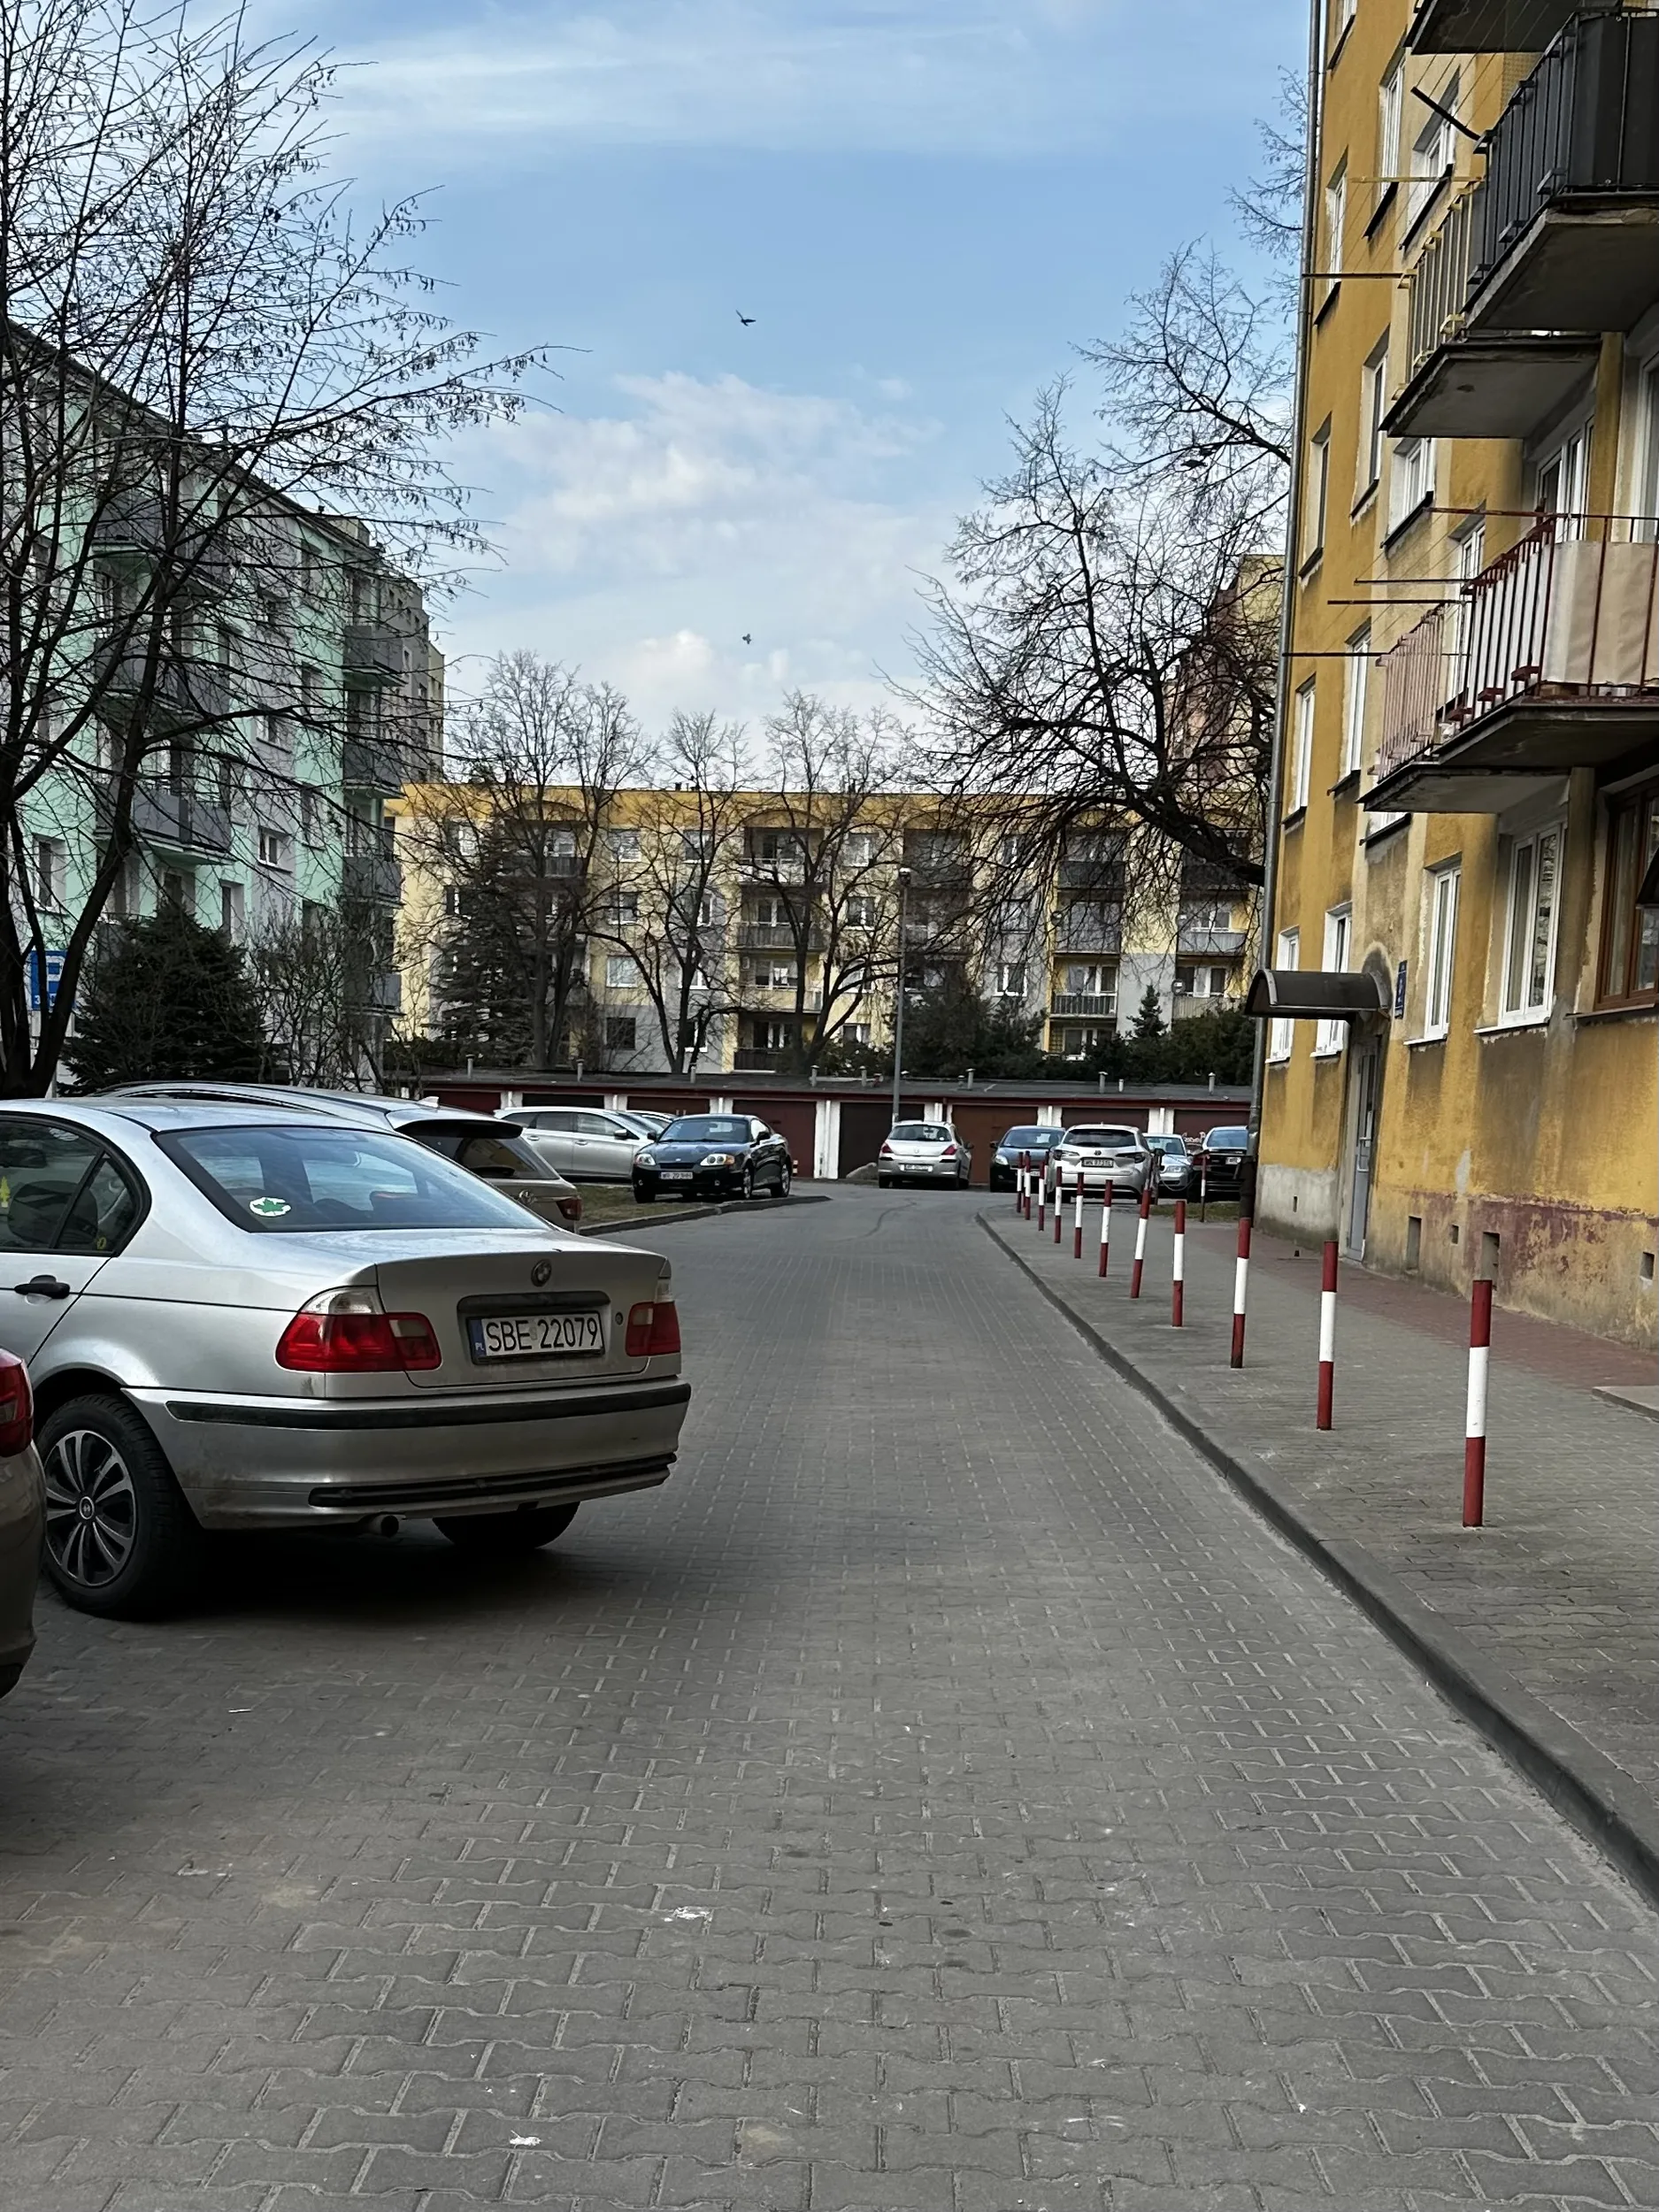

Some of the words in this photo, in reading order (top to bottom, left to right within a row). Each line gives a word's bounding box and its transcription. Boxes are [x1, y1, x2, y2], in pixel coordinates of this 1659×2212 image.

[486, 1319, 533, 1352] SBE
[537, 1317, 598, 1349] 22079
[475, 1342, 485, 1351] PL
